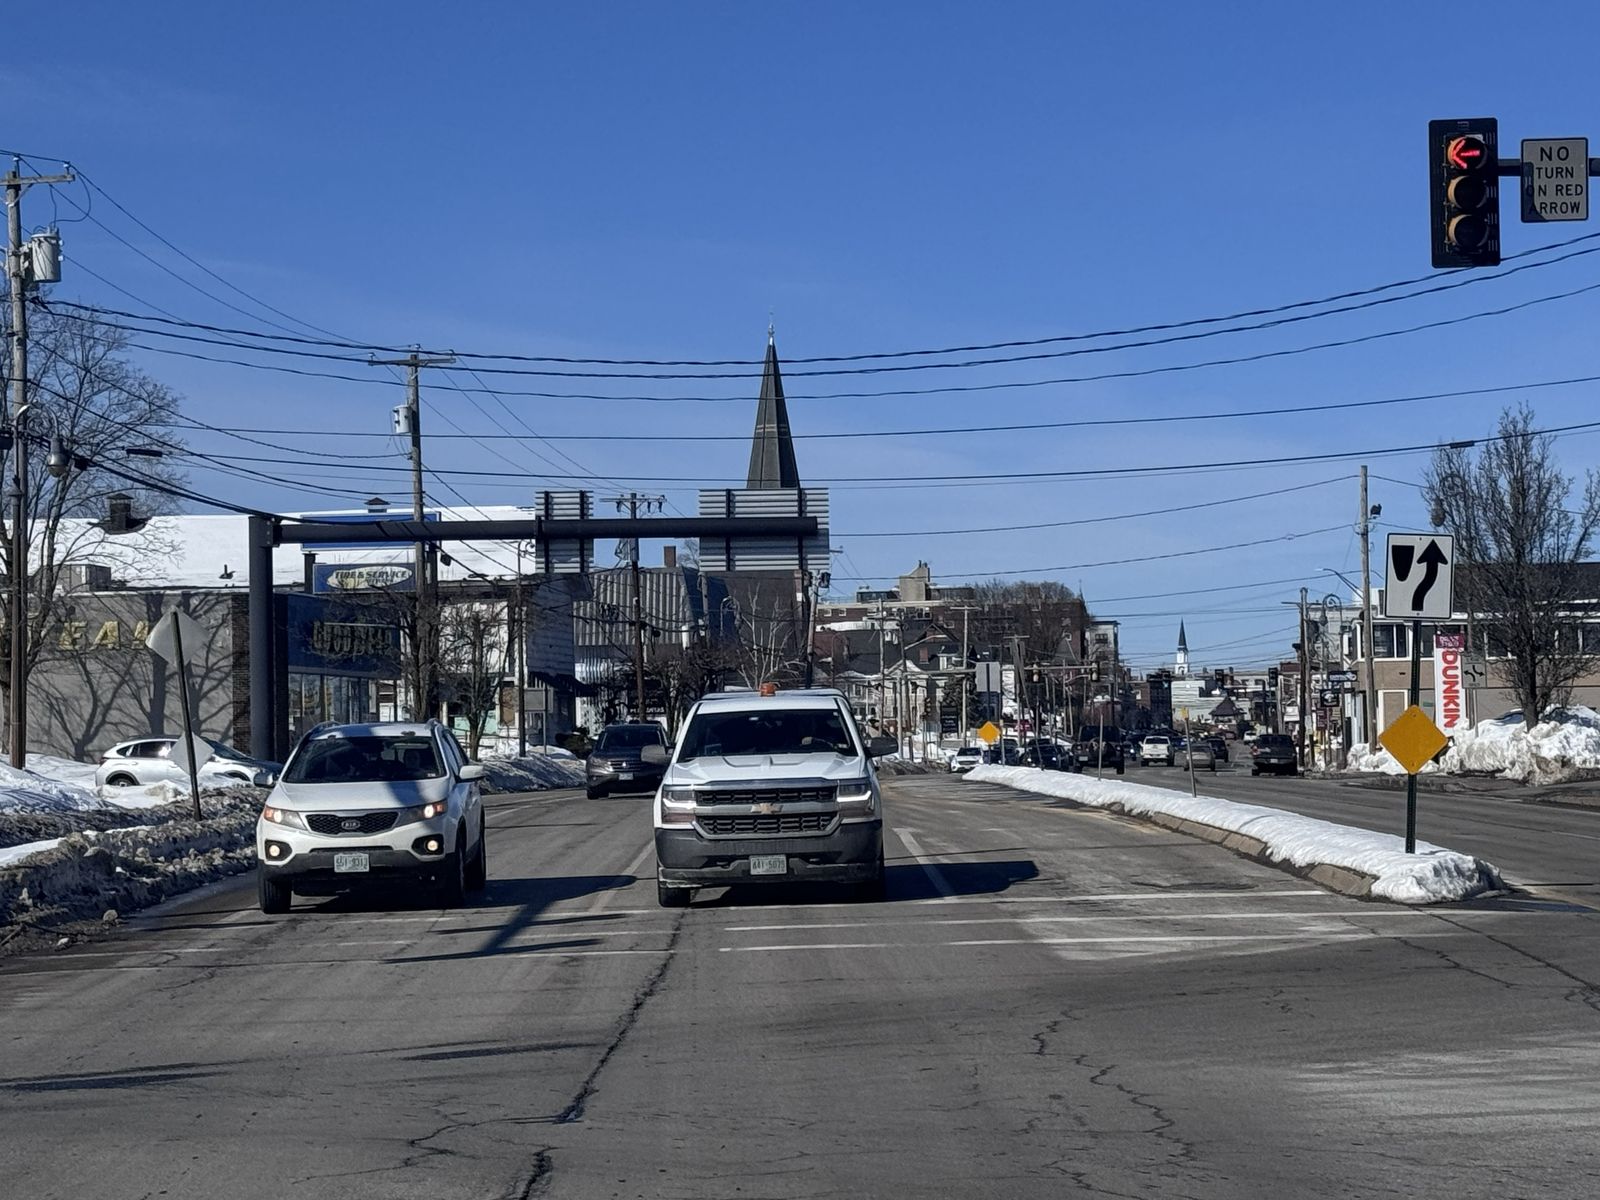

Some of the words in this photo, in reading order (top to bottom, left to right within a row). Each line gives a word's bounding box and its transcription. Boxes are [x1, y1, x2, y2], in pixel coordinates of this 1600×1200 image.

[1540, 146, 1569, 161] NO
[1536, 166, 1574, 179] TURN
[1555, 183, 1583, 197] RED
[1442, 650, 1460, 728] DUNKIN
